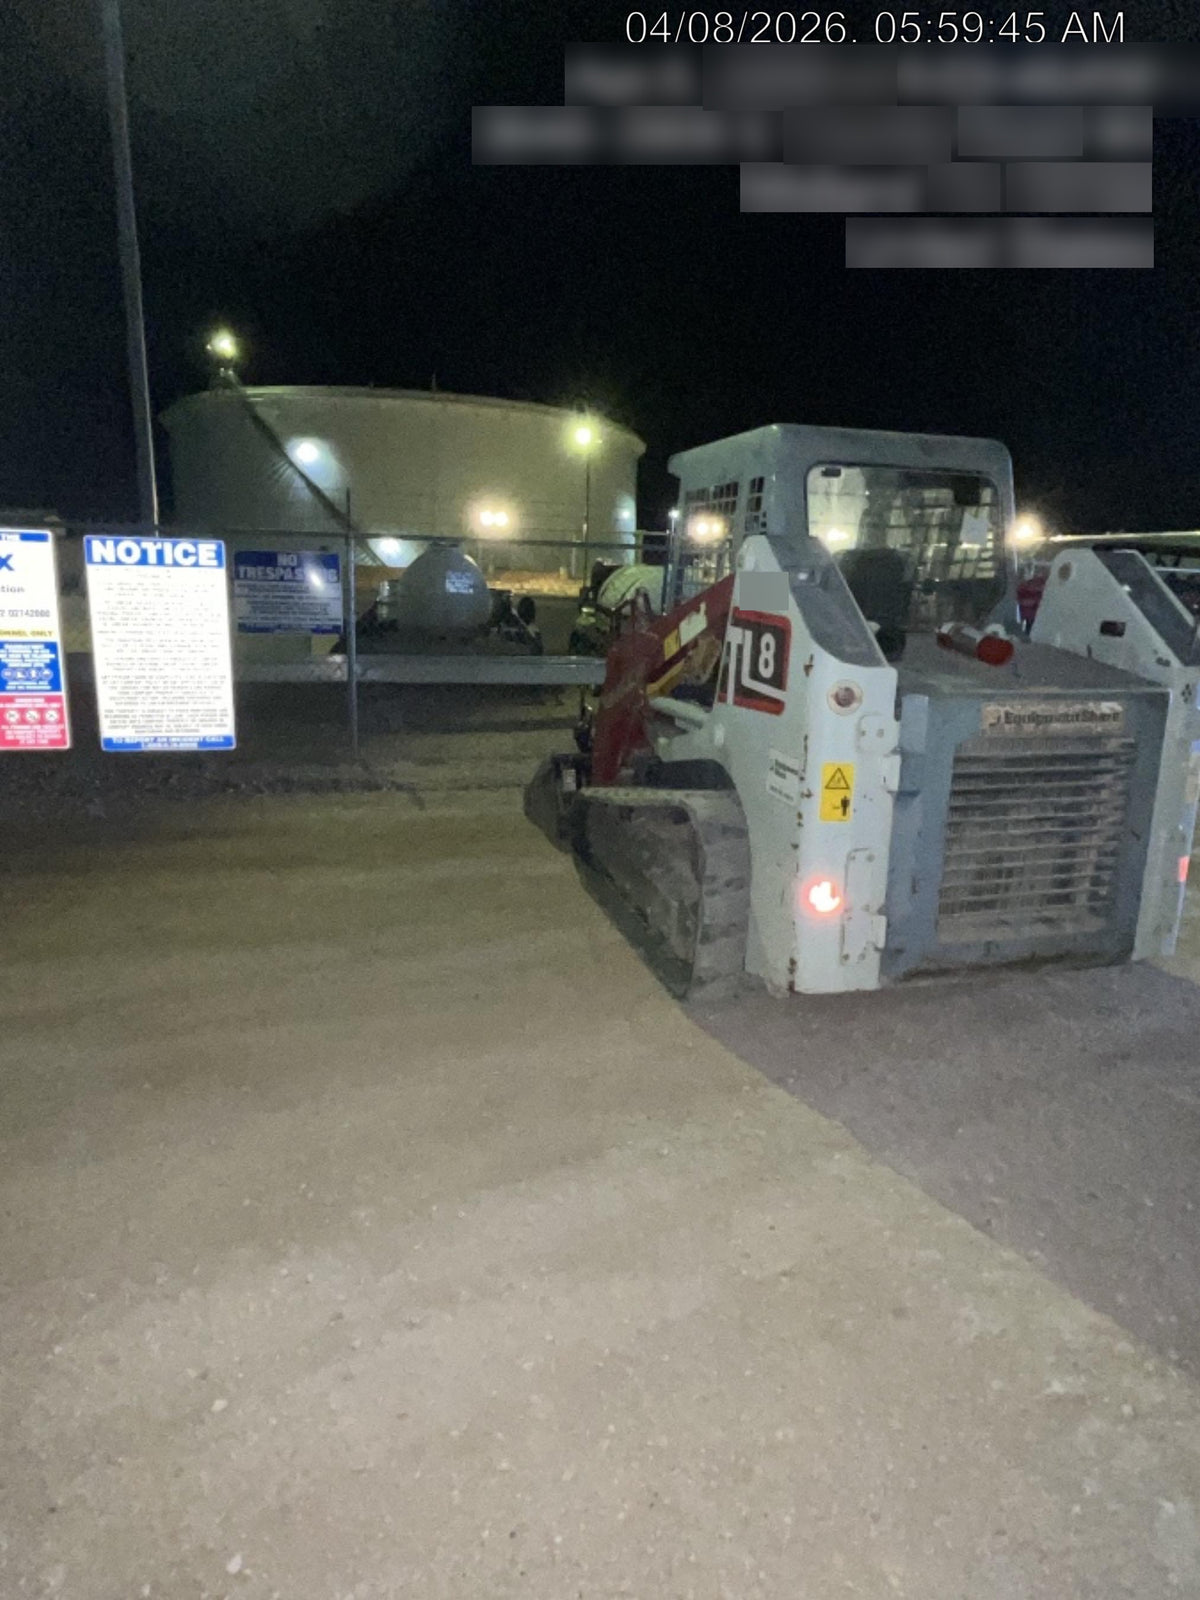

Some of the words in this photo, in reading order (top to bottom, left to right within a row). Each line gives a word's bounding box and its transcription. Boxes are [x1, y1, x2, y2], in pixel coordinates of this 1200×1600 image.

[91, 540, 219, 566] NOTICE
[274, 553, 298, 566] NO
[239, 566, 338, 582] TRESPASG
[725, 624, 788, 705] TL8
